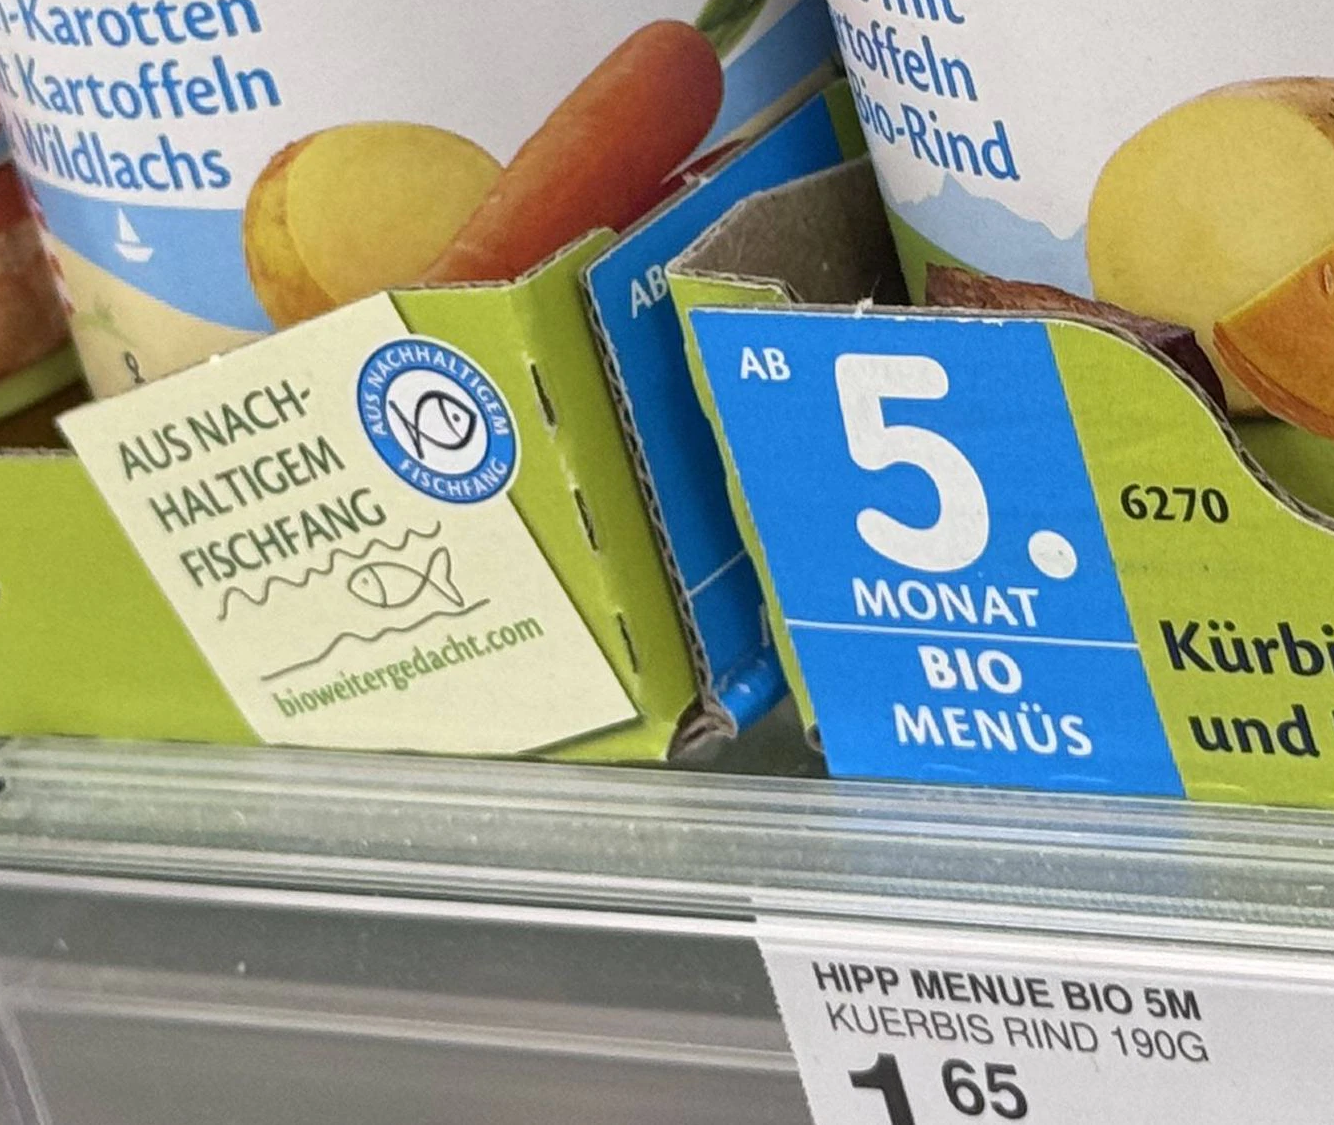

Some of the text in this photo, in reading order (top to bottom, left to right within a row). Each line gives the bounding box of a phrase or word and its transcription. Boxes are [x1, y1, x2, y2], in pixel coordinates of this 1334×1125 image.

[14, 53, 282, 120] Kartoffeln
[14, 113, 233, 193] Wildlachs
[630, 263, 668, 319] AB
[366, 344, 510, 436] AUS NACHHALTIGEM
[739, 345, 792, 381] AB
[117, 378, 312, 481] AUS NACH-
[149, 434, 347, 534] HALTIGEM
[398, 456, 508, 497] FISCHFANG
[833, 351, 1079, 580] 5.
[1119, 482, 1230, 525] 6270
[178, 486, 388, 589] FISCHFANG
[850, 577, 1039, 628] MONAT
[272, 613, 546, 720] bioweitergedacht.com
[916, 644, 1024, 696] BIO
[891, 702, 1094, 759] MENÜS
[1188, 702, 1321, 759] und
[810, 960, 1203, 1022] HIPP MENUE BIO 5M
[824, 1000, 1211, 1063] KUERBIS RIND 190G
[848, 1051, 1029, 1125] 1 65
